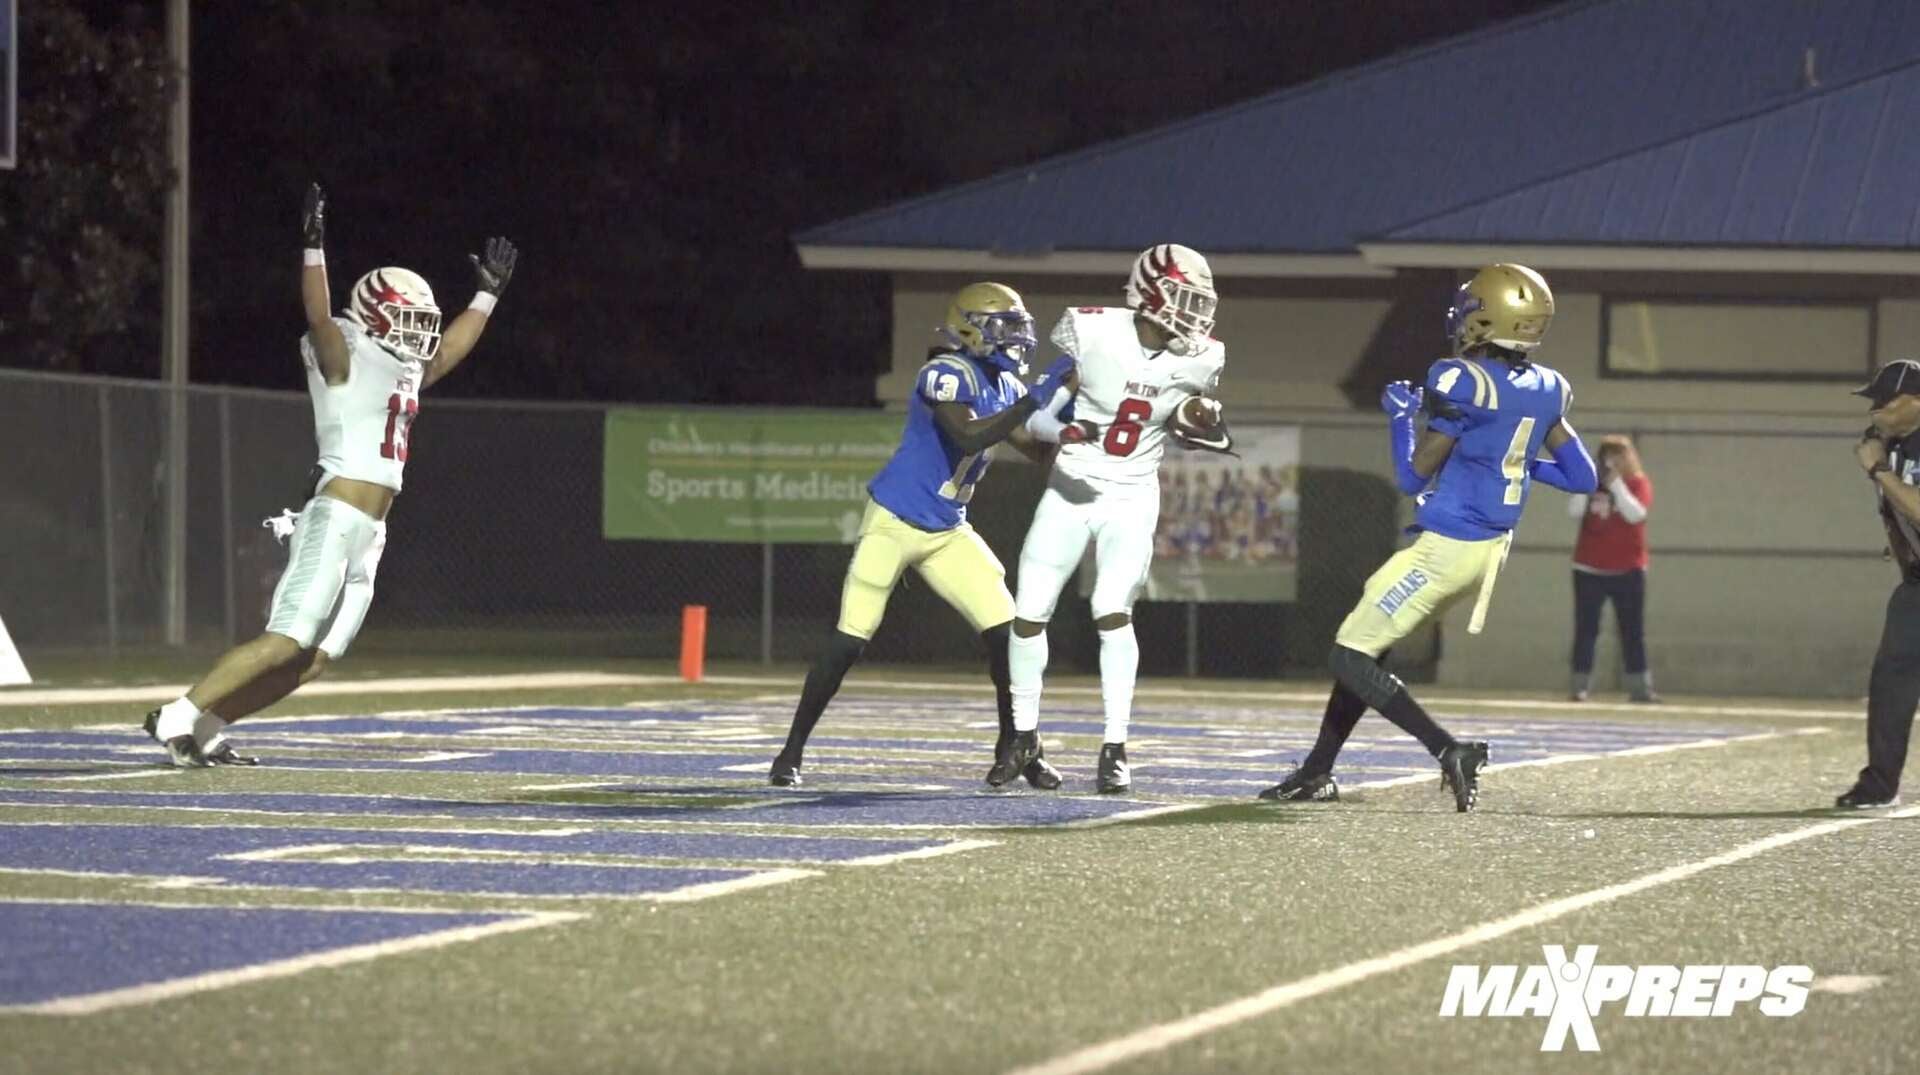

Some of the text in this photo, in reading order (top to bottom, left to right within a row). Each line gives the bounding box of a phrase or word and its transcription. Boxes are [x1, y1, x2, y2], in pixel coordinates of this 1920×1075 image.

[925, 370, 960, 402] 13
[1123, 380, 1161, 398] MILTON
[1103, 397, 1153, 457] 6
[1502, 417, 1536, 505] 4
[647, 469, 746, 504] Sports
[1376, 569, 1428, 617] INDIANS
